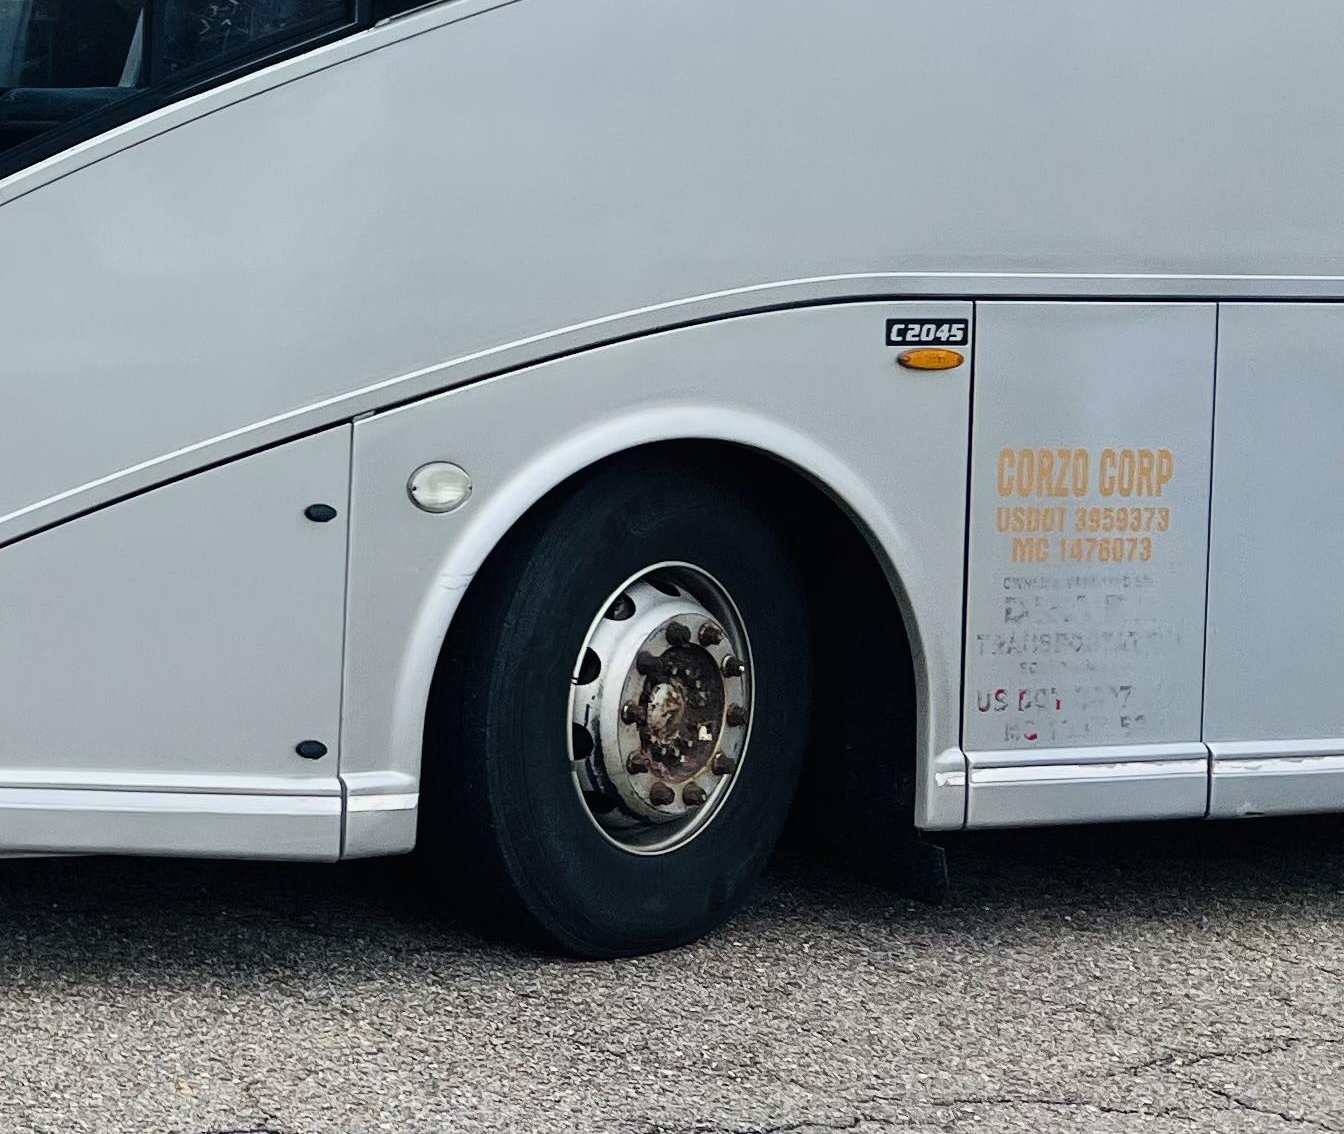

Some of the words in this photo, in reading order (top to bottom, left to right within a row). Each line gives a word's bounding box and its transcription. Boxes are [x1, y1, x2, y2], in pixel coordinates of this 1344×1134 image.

[890, 323, 965, 342] C2045
[996, 447, 1090, 498] CORZO
[1098, 448, 1175, 498] CORP
[996, 505, 1069, 533] USDOT
[1058, 537, 1154, 563] 1476073
